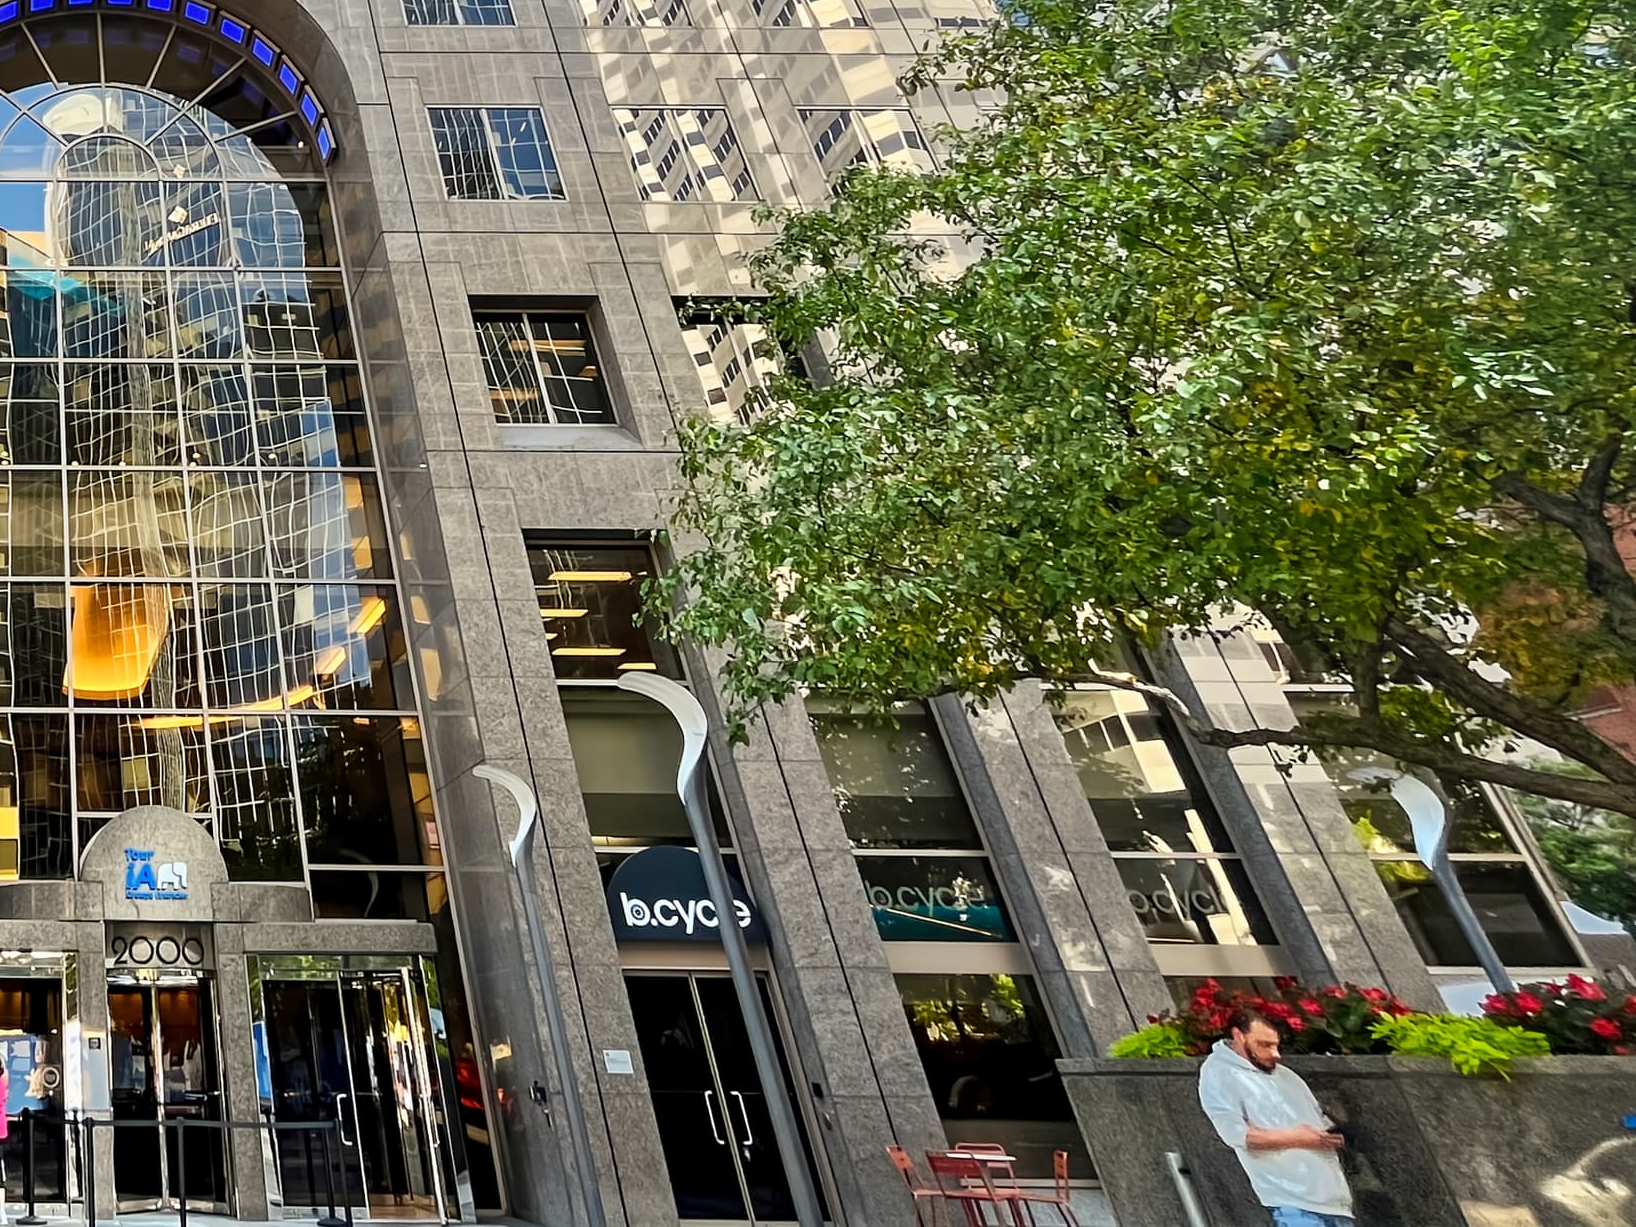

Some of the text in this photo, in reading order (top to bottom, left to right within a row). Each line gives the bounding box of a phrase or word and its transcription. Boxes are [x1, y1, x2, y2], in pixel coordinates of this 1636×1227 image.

[124, 848, 155, 862] Tour
[620, 892, 751, 934] b.cyce
[865, 880, 986, 918] b.cyce
[111, 936, 204, 965] 2000
